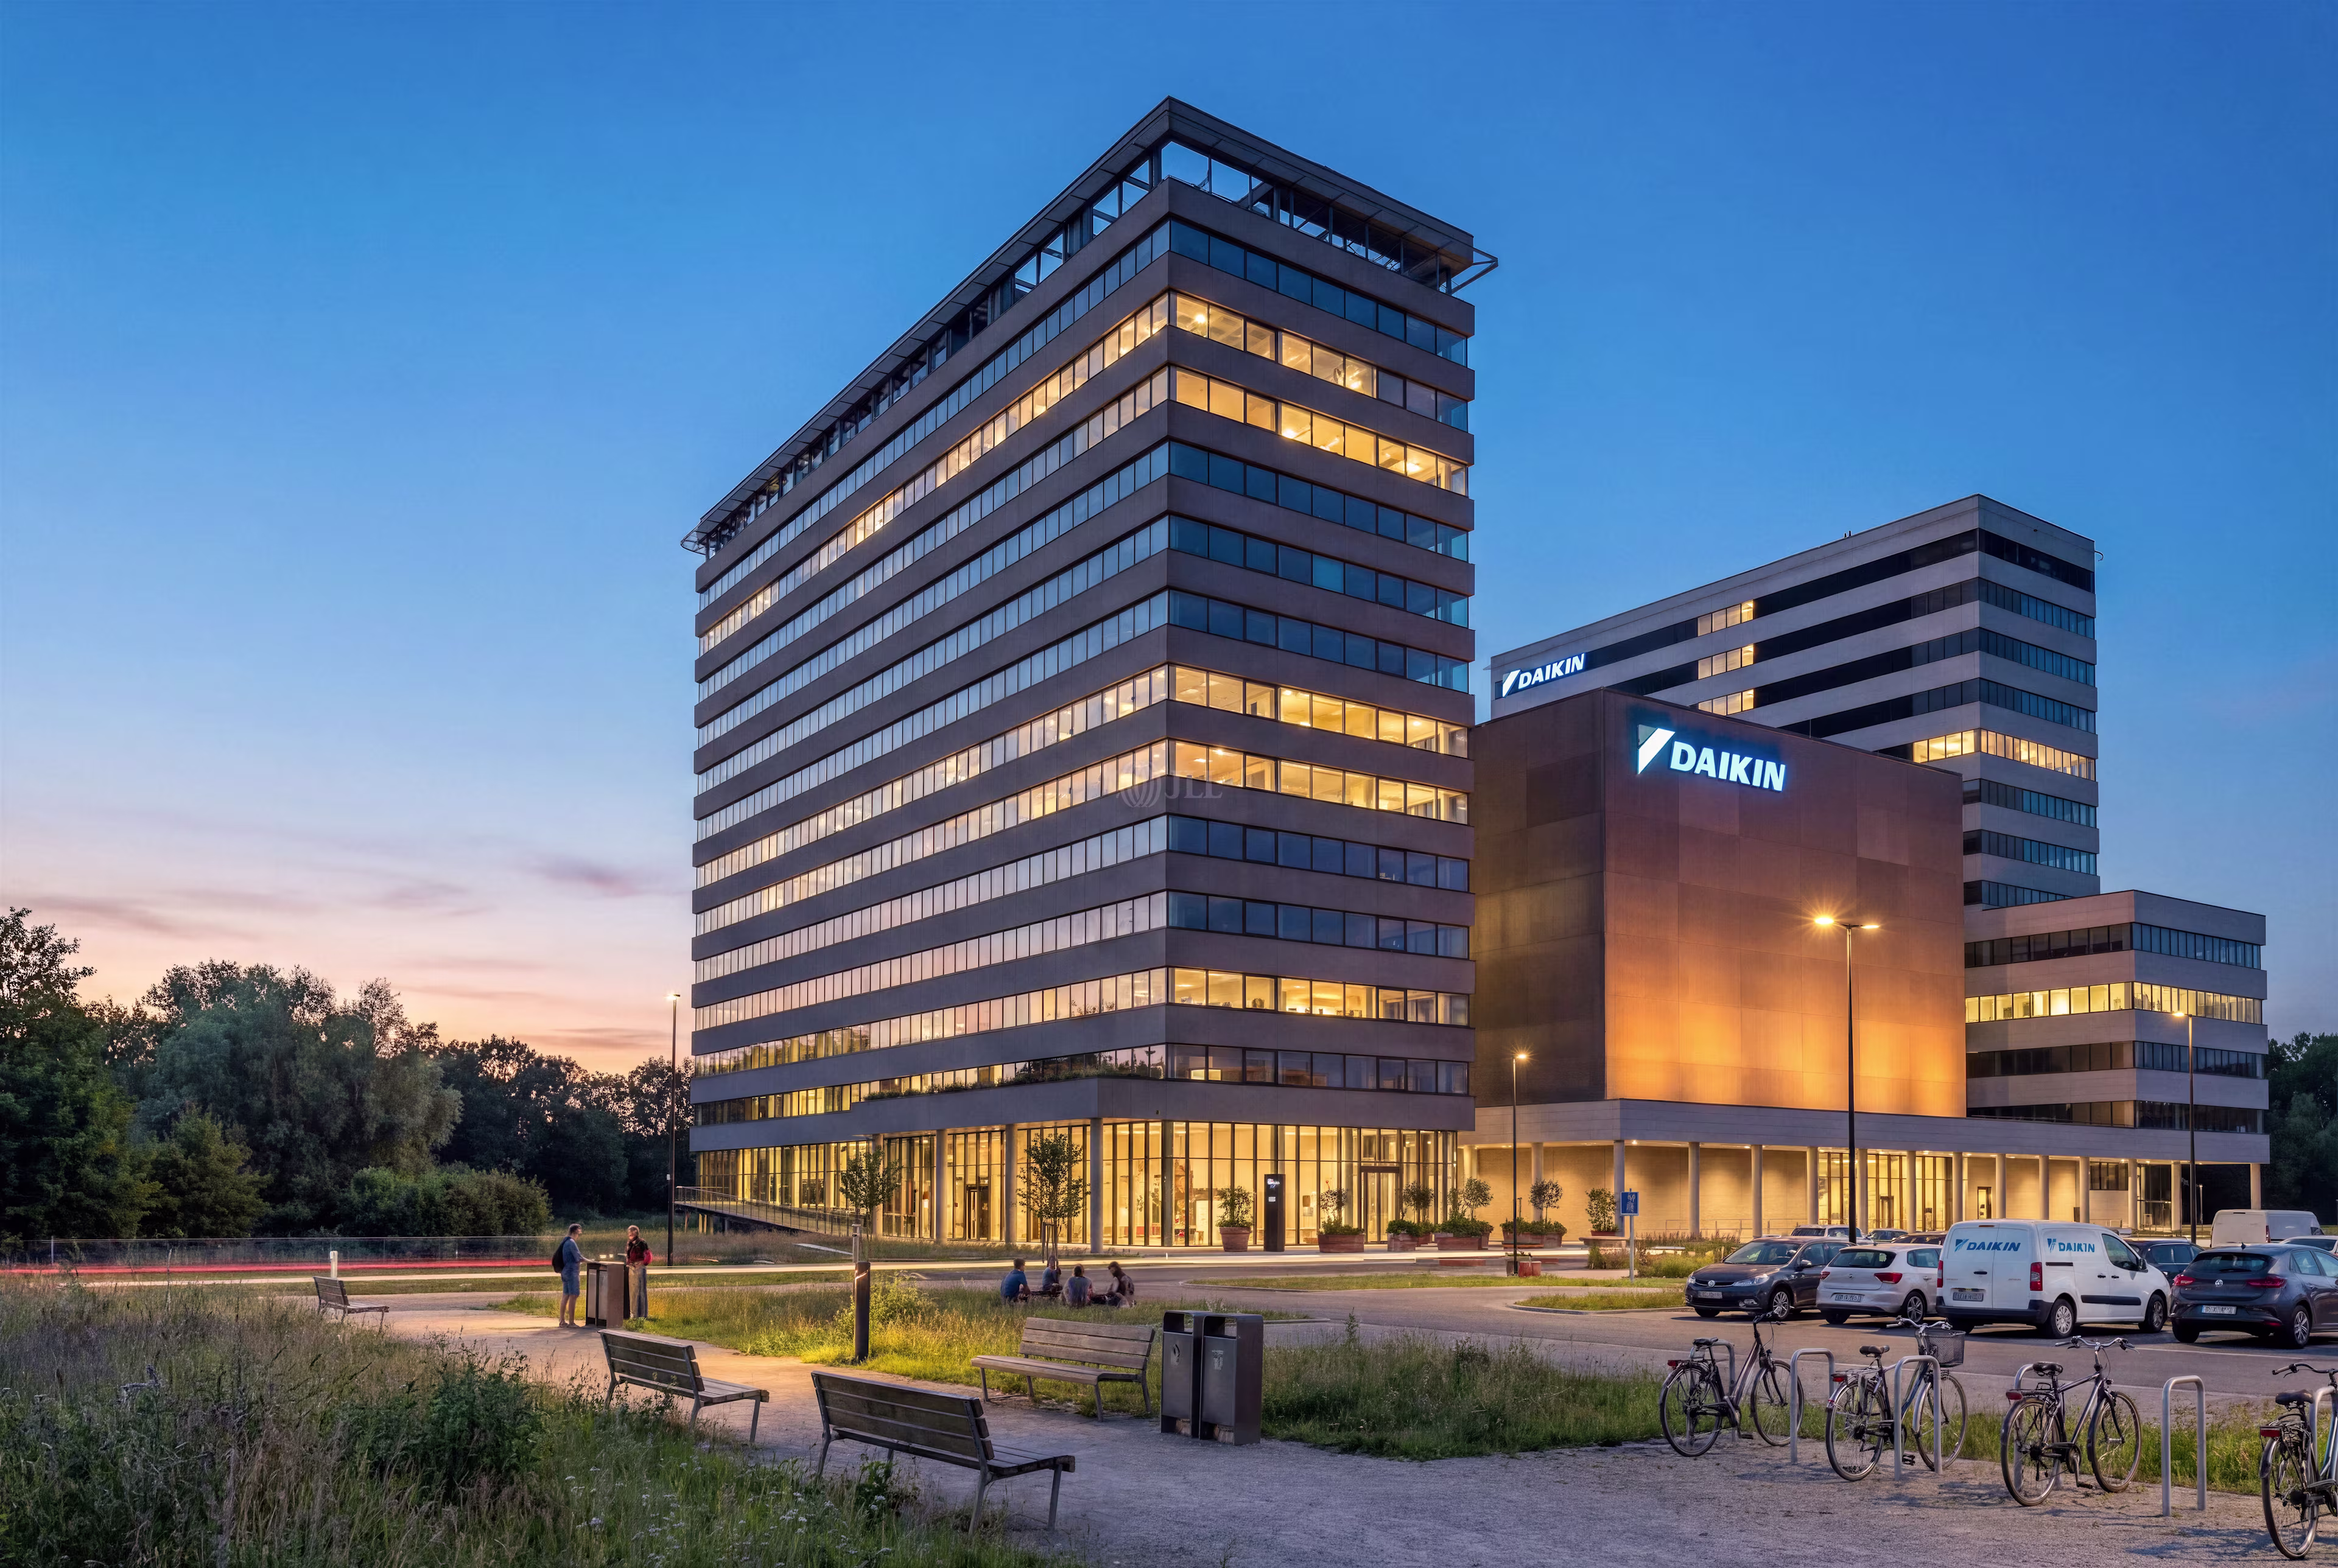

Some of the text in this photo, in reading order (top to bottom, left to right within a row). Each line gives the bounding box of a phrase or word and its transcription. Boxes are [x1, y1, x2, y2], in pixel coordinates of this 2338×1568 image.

[1518, 653, 1585, 689] DAIKIN
[1670, 741, 1786, 792] DAIKIN
[1967, 1242, 2021, 1251] DAIKIN
[2059, 1242, 2095, 1253] DAIKIN
